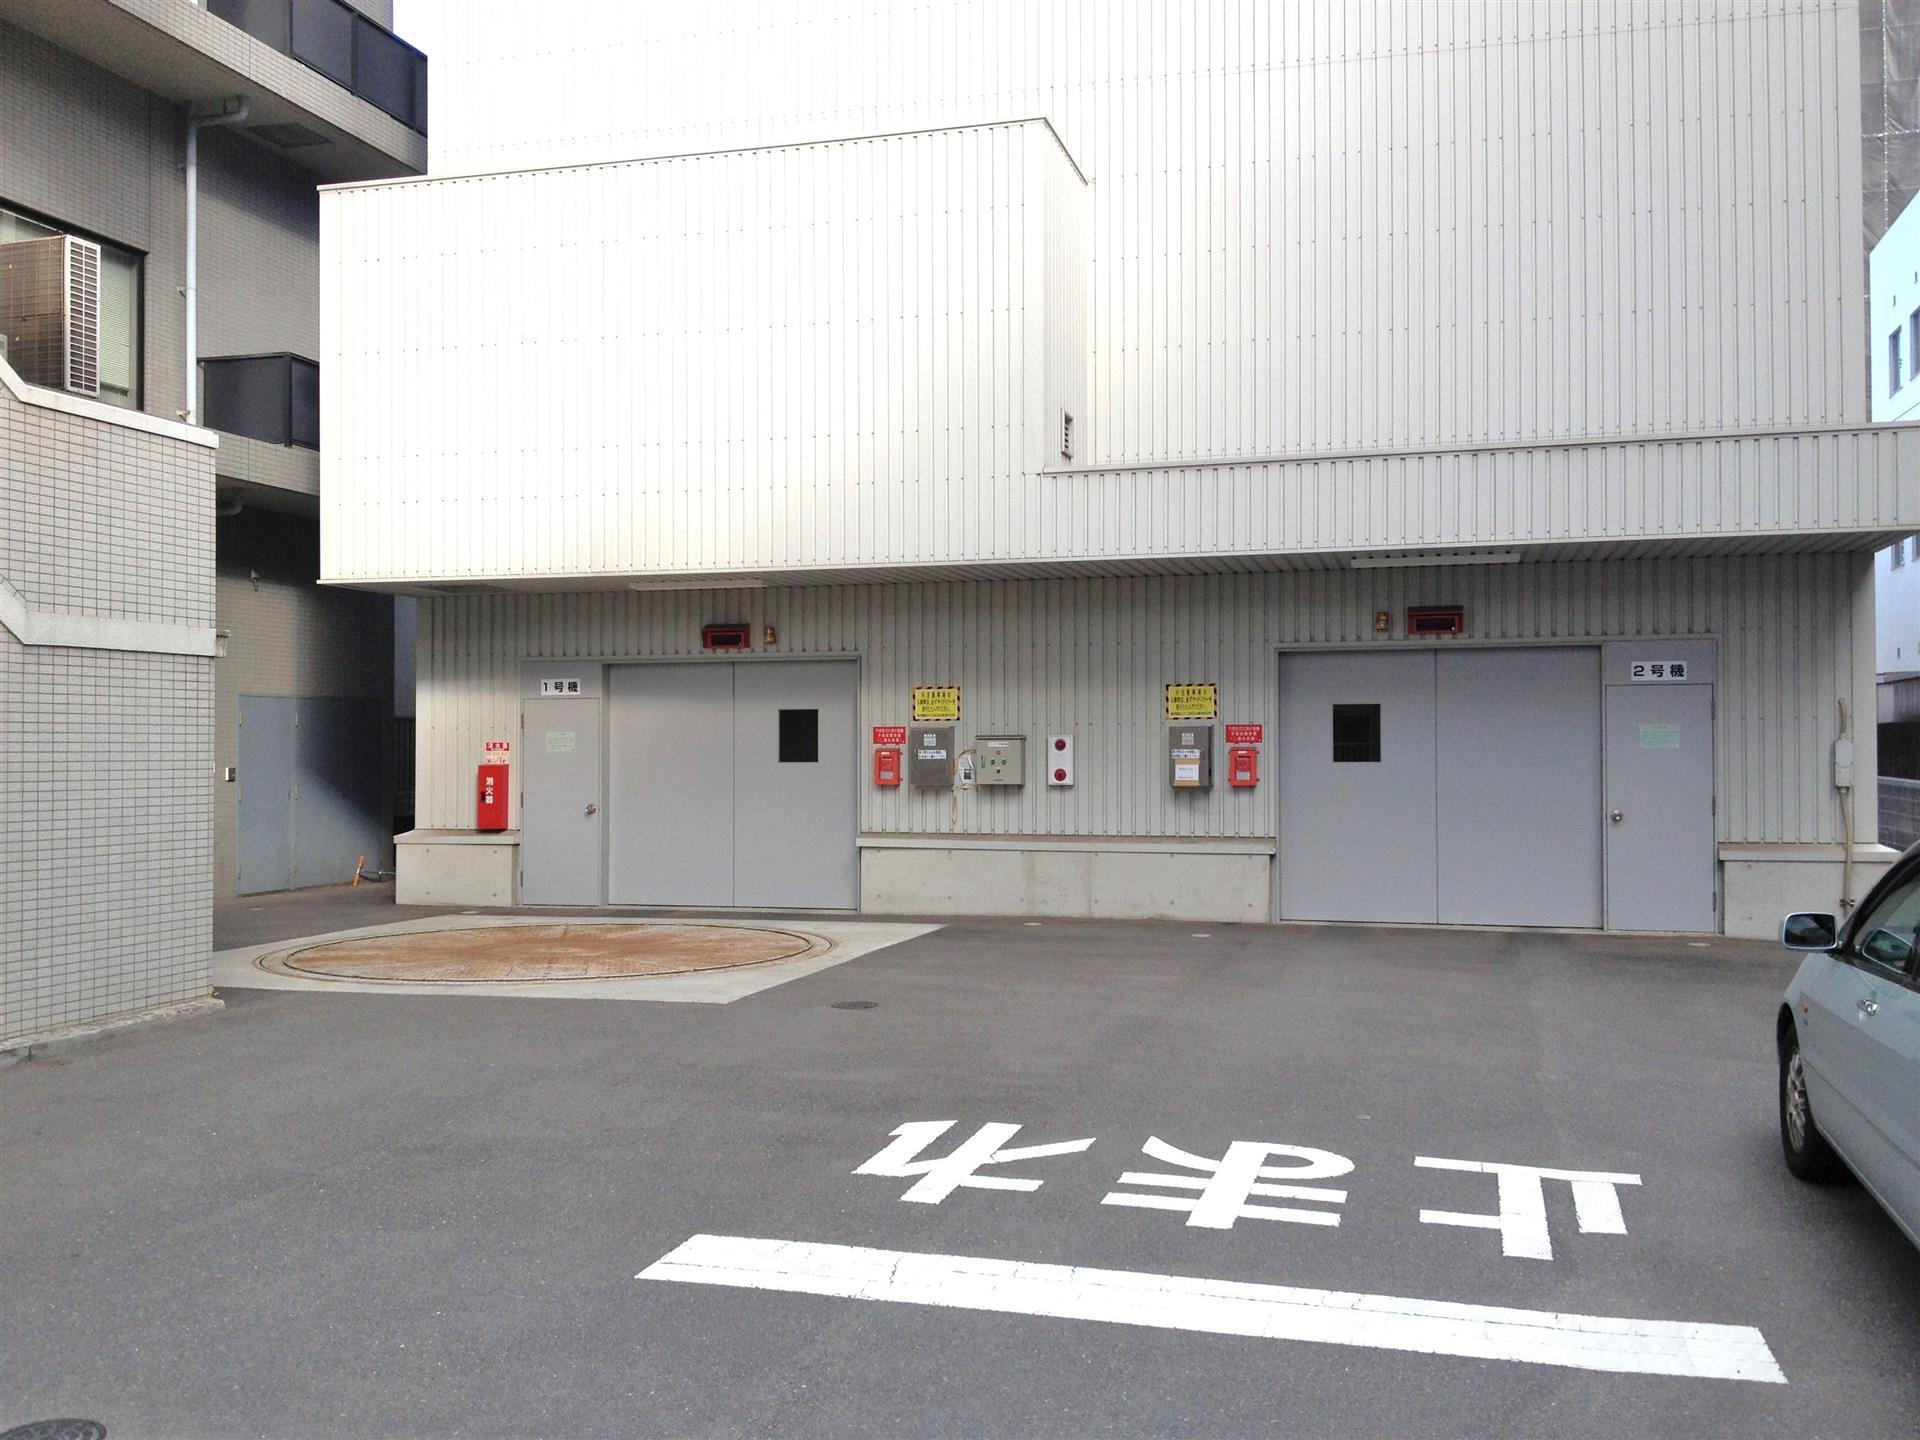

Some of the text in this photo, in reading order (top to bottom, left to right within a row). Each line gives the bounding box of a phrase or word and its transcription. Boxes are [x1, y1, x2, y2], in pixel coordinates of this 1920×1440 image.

[1633, 663, 1685, 678] 2号機
[543, 681, 578, 693] 1号機
[852, 1119, 1642, 1260] 止まれ
